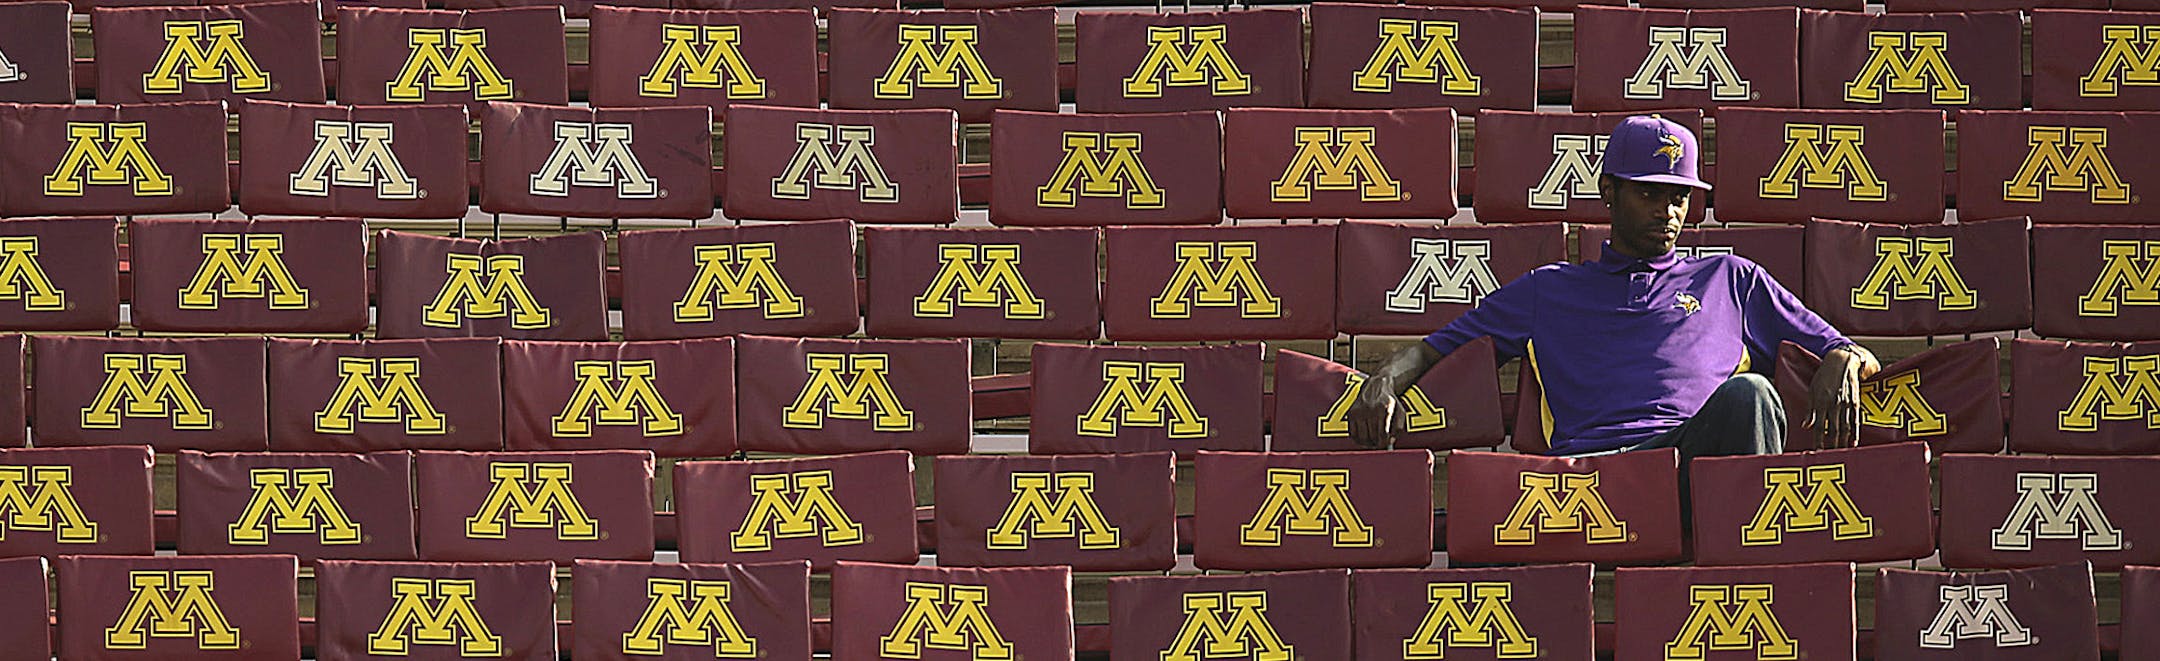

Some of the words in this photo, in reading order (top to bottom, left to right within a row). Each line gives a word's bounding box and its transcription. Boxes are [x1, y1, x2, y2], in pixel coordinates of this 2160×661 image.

[143, 20, 270, 93] M
[386, 29, 513, 102] M
[640, 24, 765, 99] M
[874, 25, 1002, 99] M
[1123, 25, 1251, 97] M
[1353, 19, 1480, 95] M
[1625, 27, 1750, 100] M
[1844, 32, 1969, 104] M
[44, 122, 173, 196] M
[290, 121, 417, 198] M
[530, 121, 657, 198] M
[772, 123, 898, 202] M
[1037, 132, 1165, 208] M
[1271, 127, 1400, 201] M
[1760, 124, 1887, 201] M
[2004, 126, 2130, 203] M
[179, 234, 308, 309] M
[423, 253, 550, 329] M
[674, 243, 804, 322] M
[914, 244, 1044, 319] M
[1151, 242, 1280, 318] M
[1386, 239, 1500, 312] M
[1851, 237, 1977, 310] M
[81, 354, 212, 429] M
[315, 357, 445, 434] M
[552, 360, 683, 437] M
[783, 353, 913, 431] M
[1077, 361, 1208, 438] M
[229, 468, 361, 545] M
[466, 462, 598, 540] M
[731, 470, 863, 552] M
[987, 473, 1119, 549] M
[1241, 468, 1373, 547] M
[1495, 471, 1626, 545] M
[1742, 464, 1873, 545] M
[1992, 473, 2121, 550] M
[105, 571, 239, 649] M
[368, 578, 502, 656] M
[623, 578, 756, 658] M
[880, 582, 1013, 661] M
[1160, 591, 1293, 661] M
[1403, 582, 1537, 659] M
[1665, 584, 1798, 661] M
[1920, 585, 2030, 648] M
